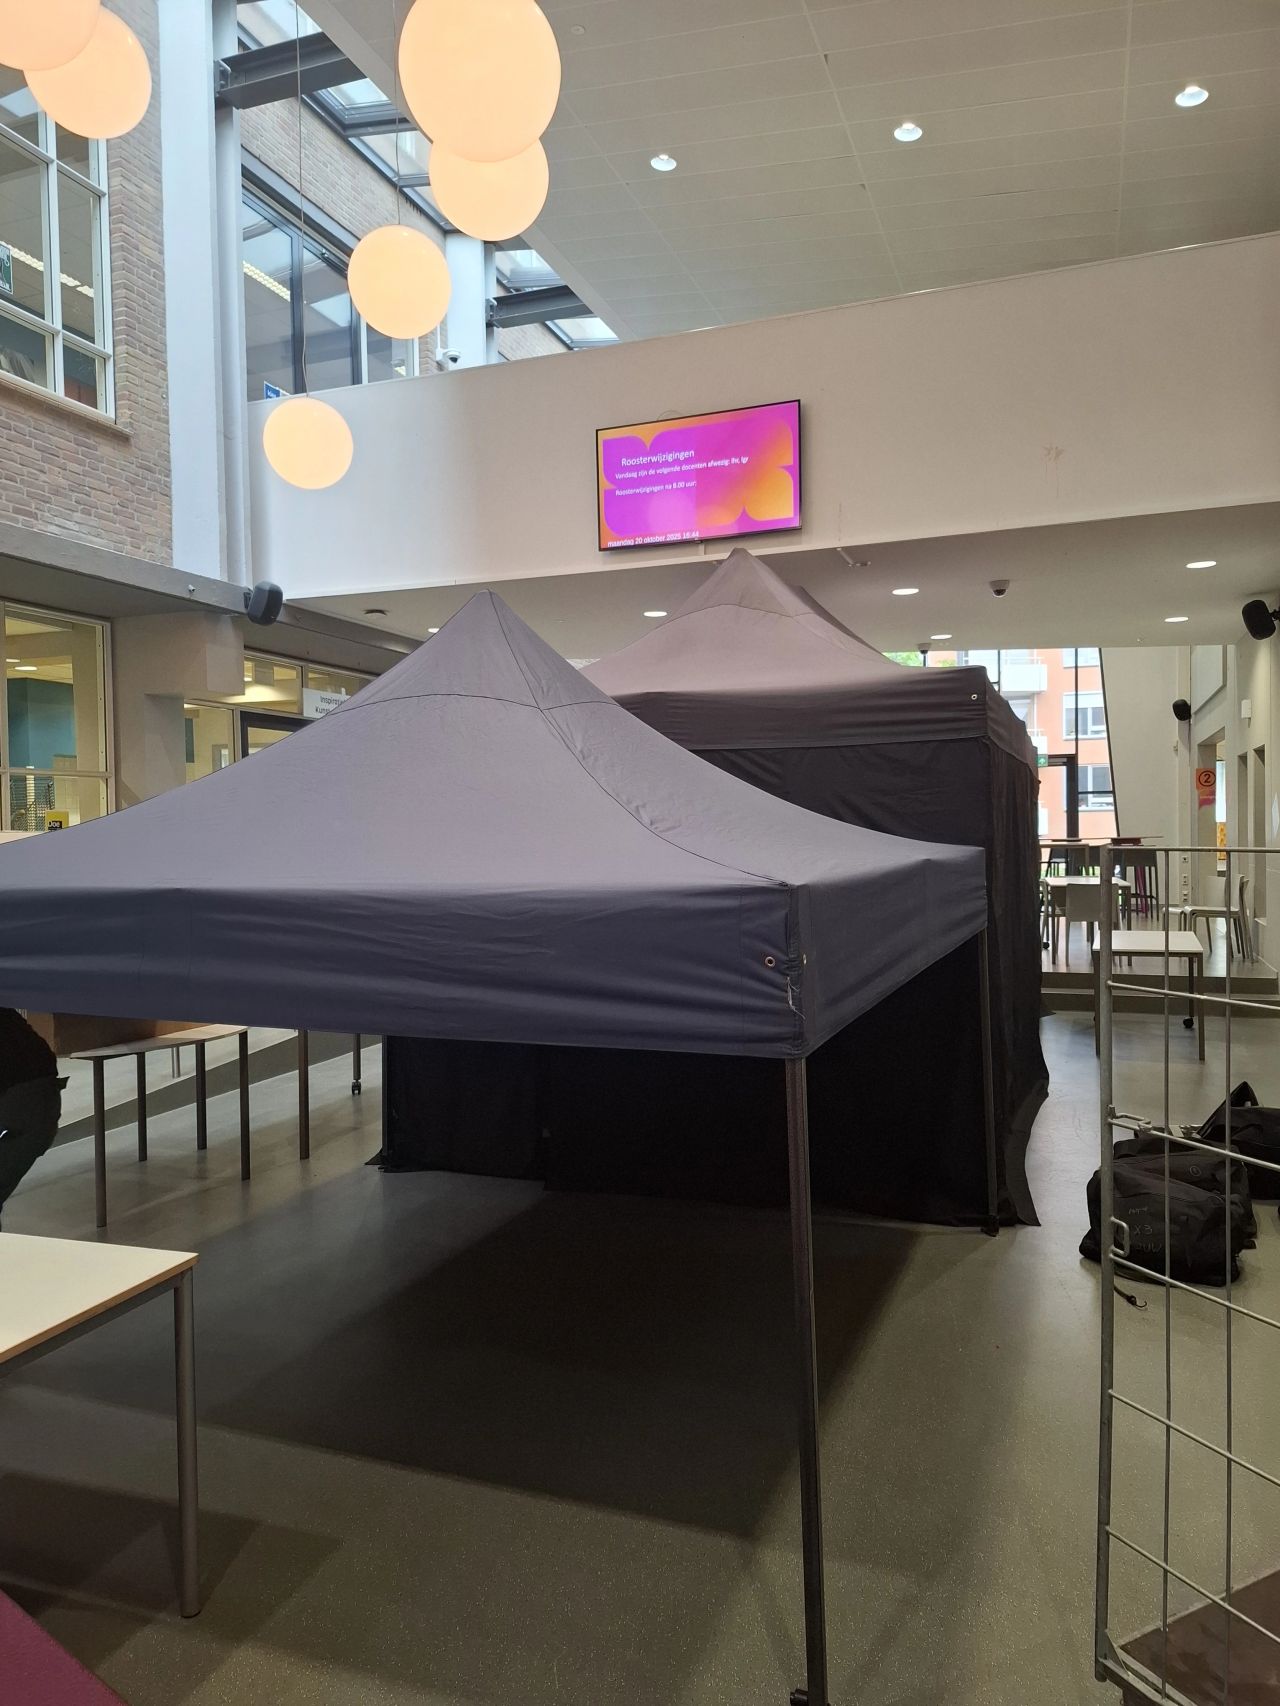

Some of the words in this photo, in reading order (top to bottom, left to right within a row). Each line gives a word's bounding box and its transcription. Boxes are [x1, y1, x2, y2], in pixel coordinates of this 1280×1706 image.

[621, 450, 695, 467] Roosterwijzigingen
[615, 471, 638, 480] Vandaag
[638, 469, 648, 478] zijn
[648, 468, 656, 476] de
[656, 465, 681, 475] volgende
[681, 461, 707, 471] docenten
[615, 484, 665, 497] Roosterwijzigingen
[607, 537, 634, 548] maandag
[635, 536, 643, 545] 20
[643, 535, 665, 544] oktober
[666, 532, 682, 541] 2025
[1203, 773, 1211, 784] 2
